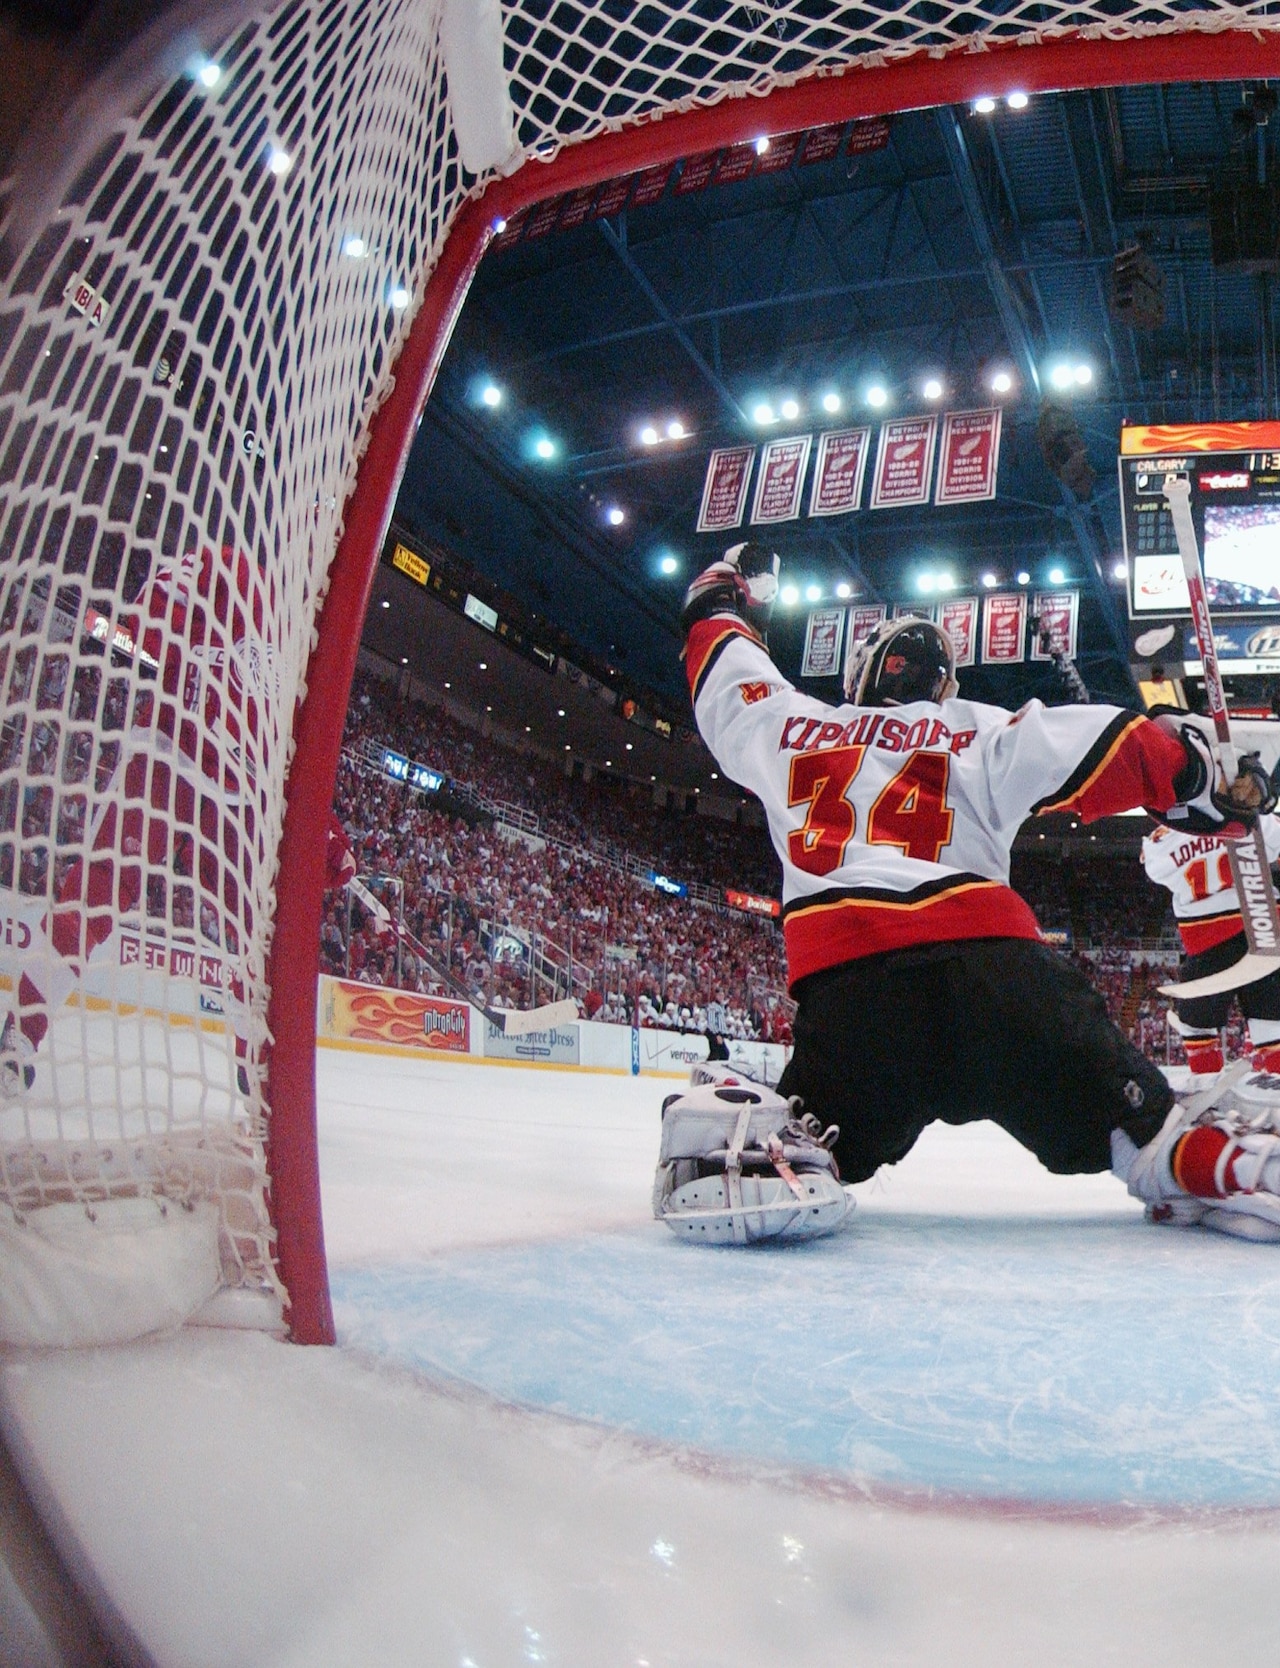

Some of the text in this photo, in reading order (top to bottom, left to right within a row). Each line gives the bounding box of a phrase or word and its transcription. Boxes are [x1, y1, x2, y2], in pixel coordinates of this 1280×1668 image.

[892, 424, 924, 435] DETROIT
[888, 435, 903, 443] RED
[952, 464, 981, 475] NORRIS
[1137, 459, 1187, 472] CALGARY
[888, 469, 916, 479] NORRIS
[949, 473, 983, 484] DIVISION
[884, 477, 918, 488] DIVISION
[945, 482, 986, 493] CHAMPIONS
[880, 487, 920, 498] CHAMPIONS
[788, 744, 954, 877] 34
[1170, 837, 1229, 868] LOMBA
[549, 1027, 575, 1048] Press
[670, 1048, 699, 1064] verizon
